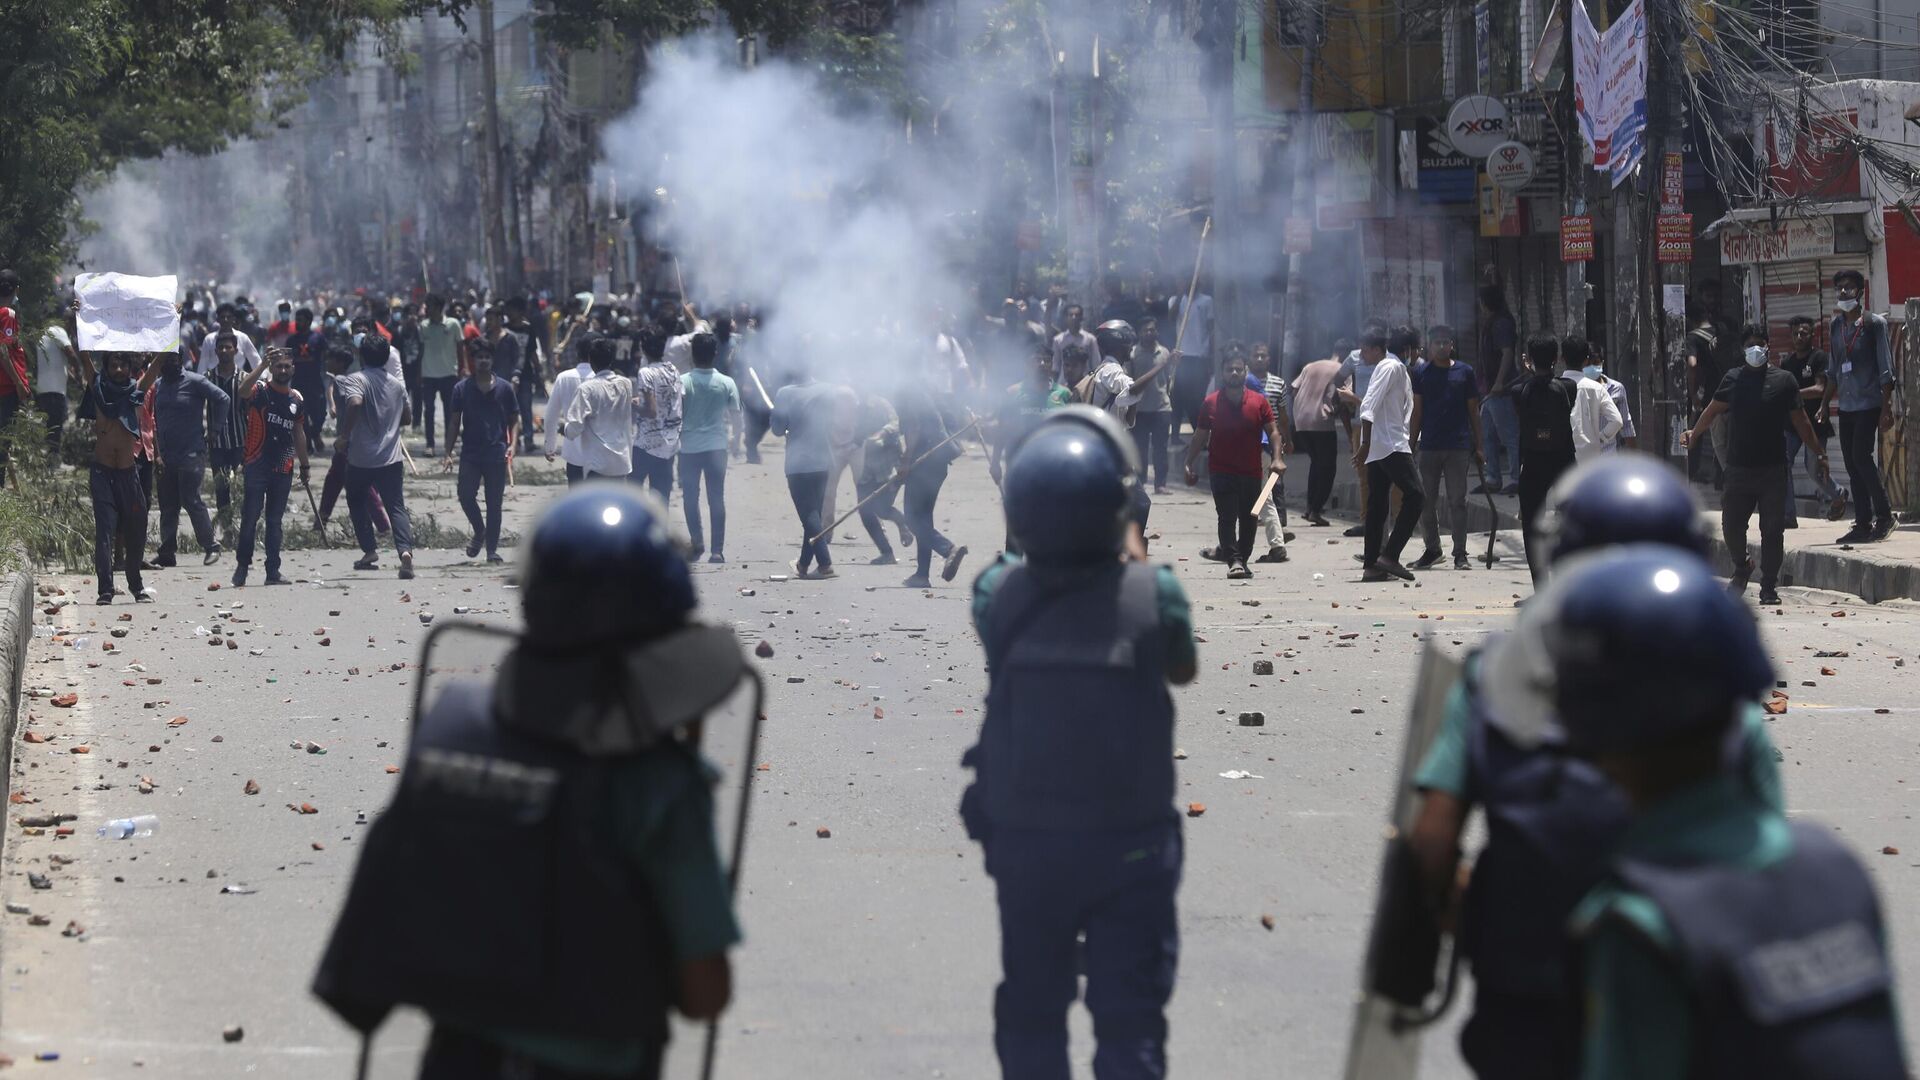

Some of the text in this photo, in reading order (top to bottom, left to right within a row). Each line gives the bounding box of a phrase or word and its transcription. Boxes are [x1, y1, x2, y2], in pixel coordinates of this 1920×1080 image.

[1455, 118, 1503, 135] AXOR
[1422, 157, 1471, 168] SUZUKI
[1498, 160, 1525, 172] YOHE
[1564, 240, 1592, 249] Zoom
[1658, 240, 1691, 249] Zoom
